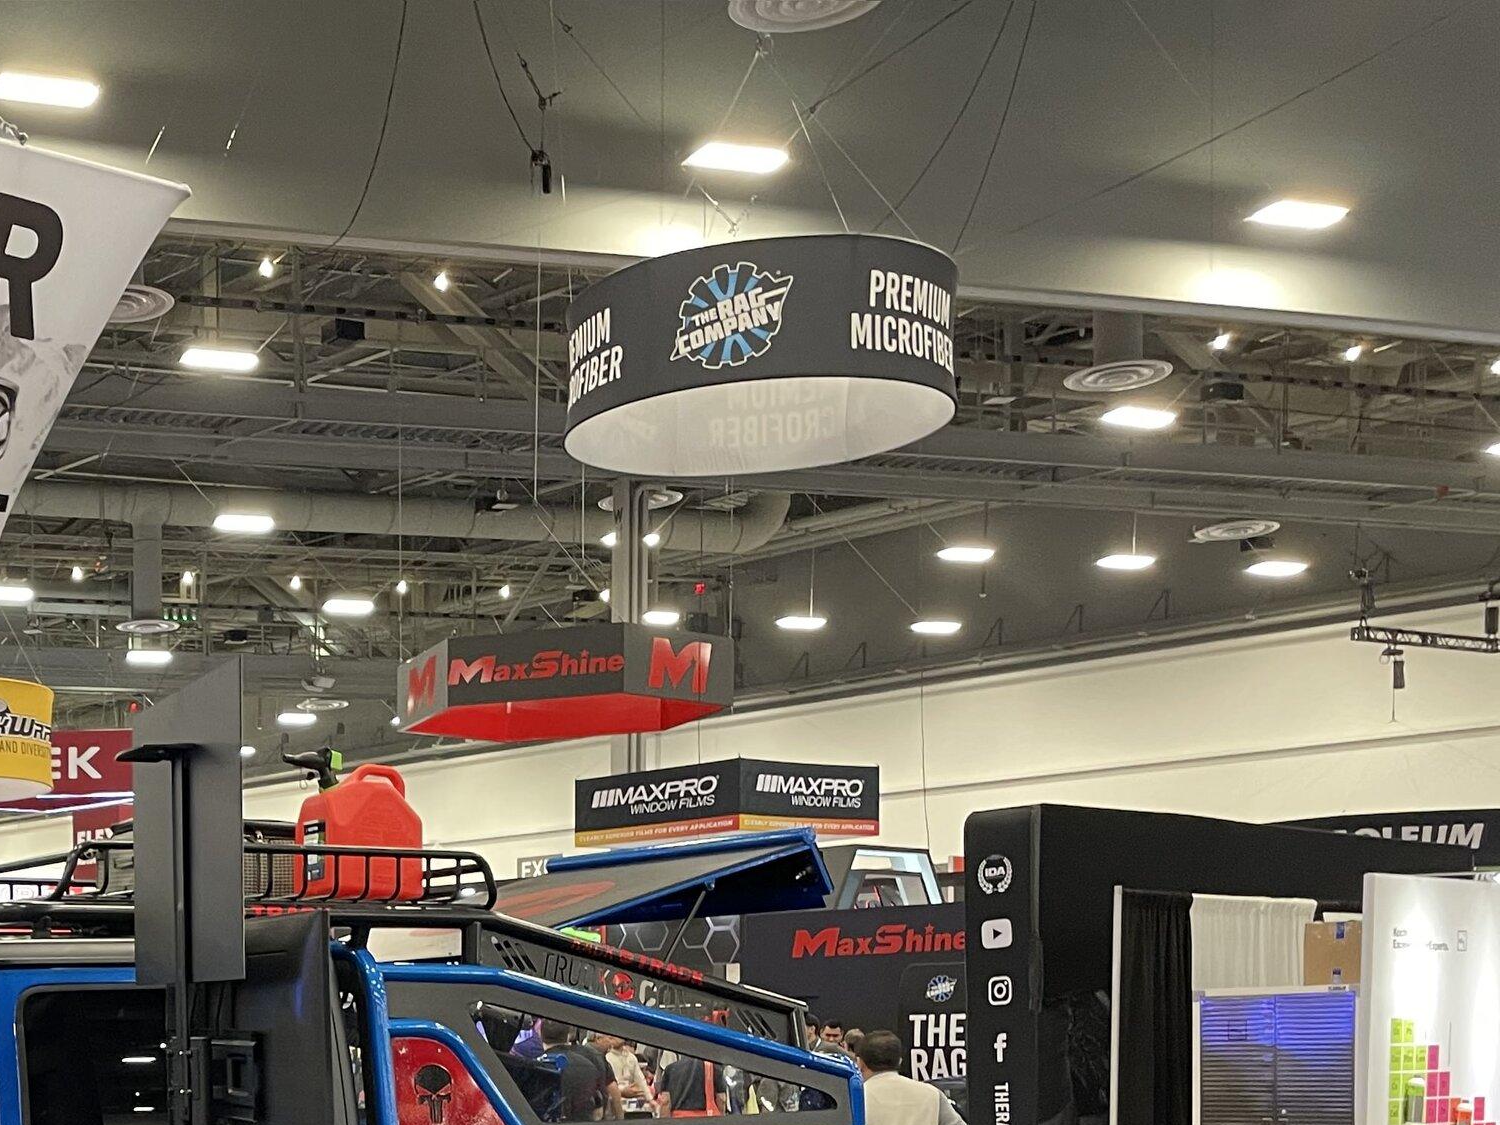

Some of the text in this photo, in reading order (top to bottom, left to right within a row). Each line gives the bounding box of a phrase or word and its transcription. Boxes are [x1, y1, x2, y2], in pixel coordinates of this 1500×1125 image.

[693, 287, 786, 327] THE RAG
[869, 269, 951, 330] PREMIUM
[569, 307, 610, 374] EMIUM
[676, 301, 782, 355] COMPANY
[448, 650, 625, 686] MaxShine
[0, 740, 19, 754] AND
[615, 776, 717, 806] MAXPRO
[777, 775, 863, 797] MAXPRO
[630, 795, 716, 815] WINDOW FILMS
[791, 795, 861, 809] WINDOW FILMS
[690, 819, 734, 831] APPLICATION
[985, 867, 1005, 877] IDA
[909, 1013, 966, 1048] THE
[911, 1049, 967, 1081] RAG
